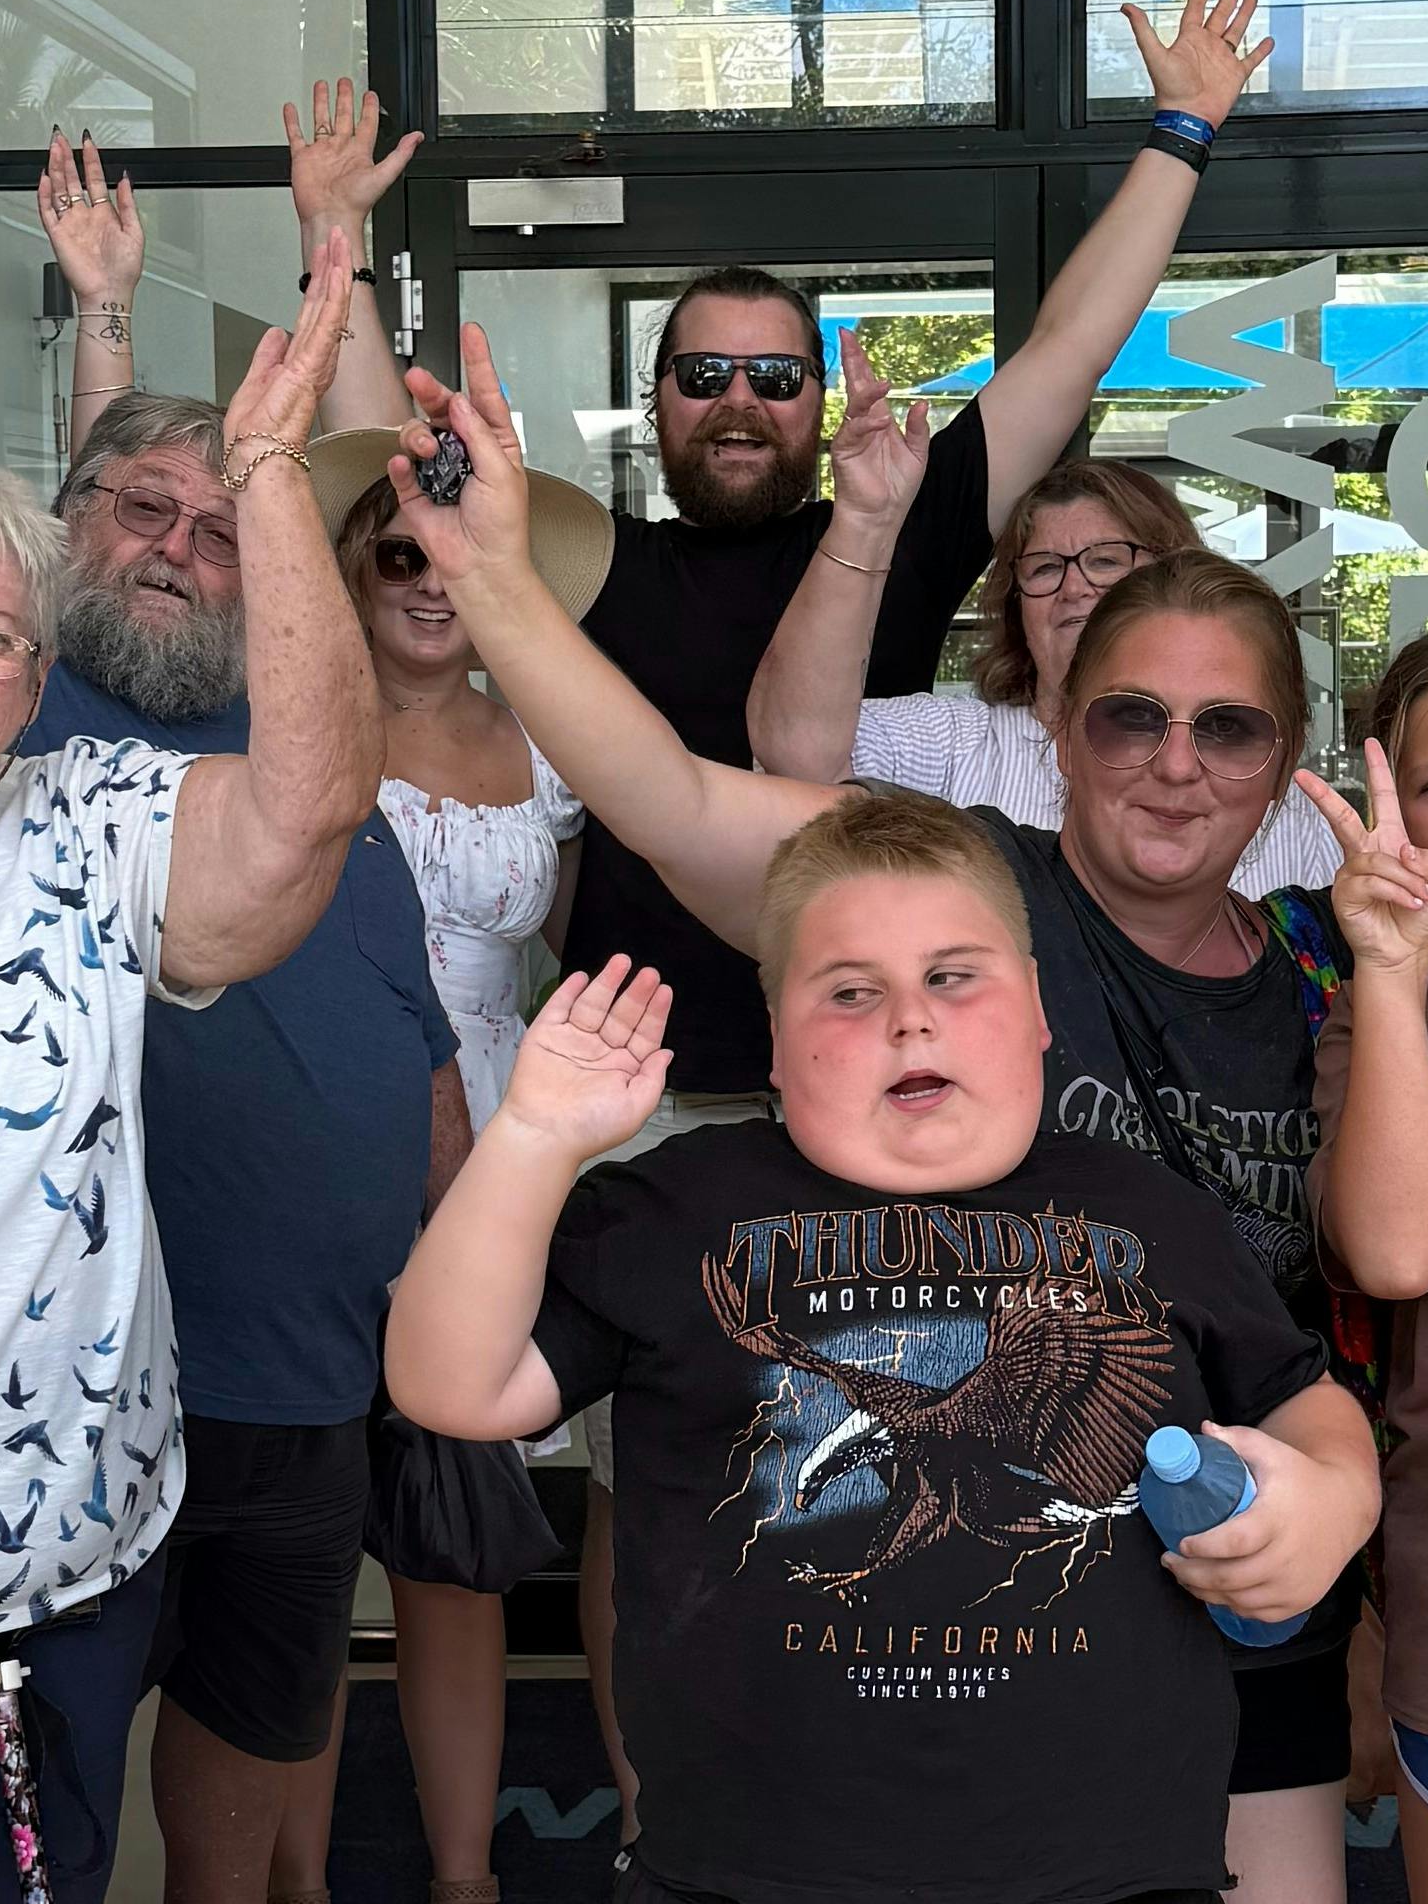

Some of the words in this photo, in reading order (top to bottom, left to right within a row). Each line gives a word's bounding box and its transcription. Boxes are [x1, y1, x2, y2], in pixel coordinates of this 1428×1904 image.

[726, 1202, 1172, 1340] THUNDER
[808, 1285, 1088, 1316] MOTORCYCLES
[785, 1623, 1089, 1655] CALIFORNIA
[847, 1666, 933, 1681] CUSTOM
[948, 1667, 1011, 1681] BIKES
[857, 1684, 920, 1699] SINCE
